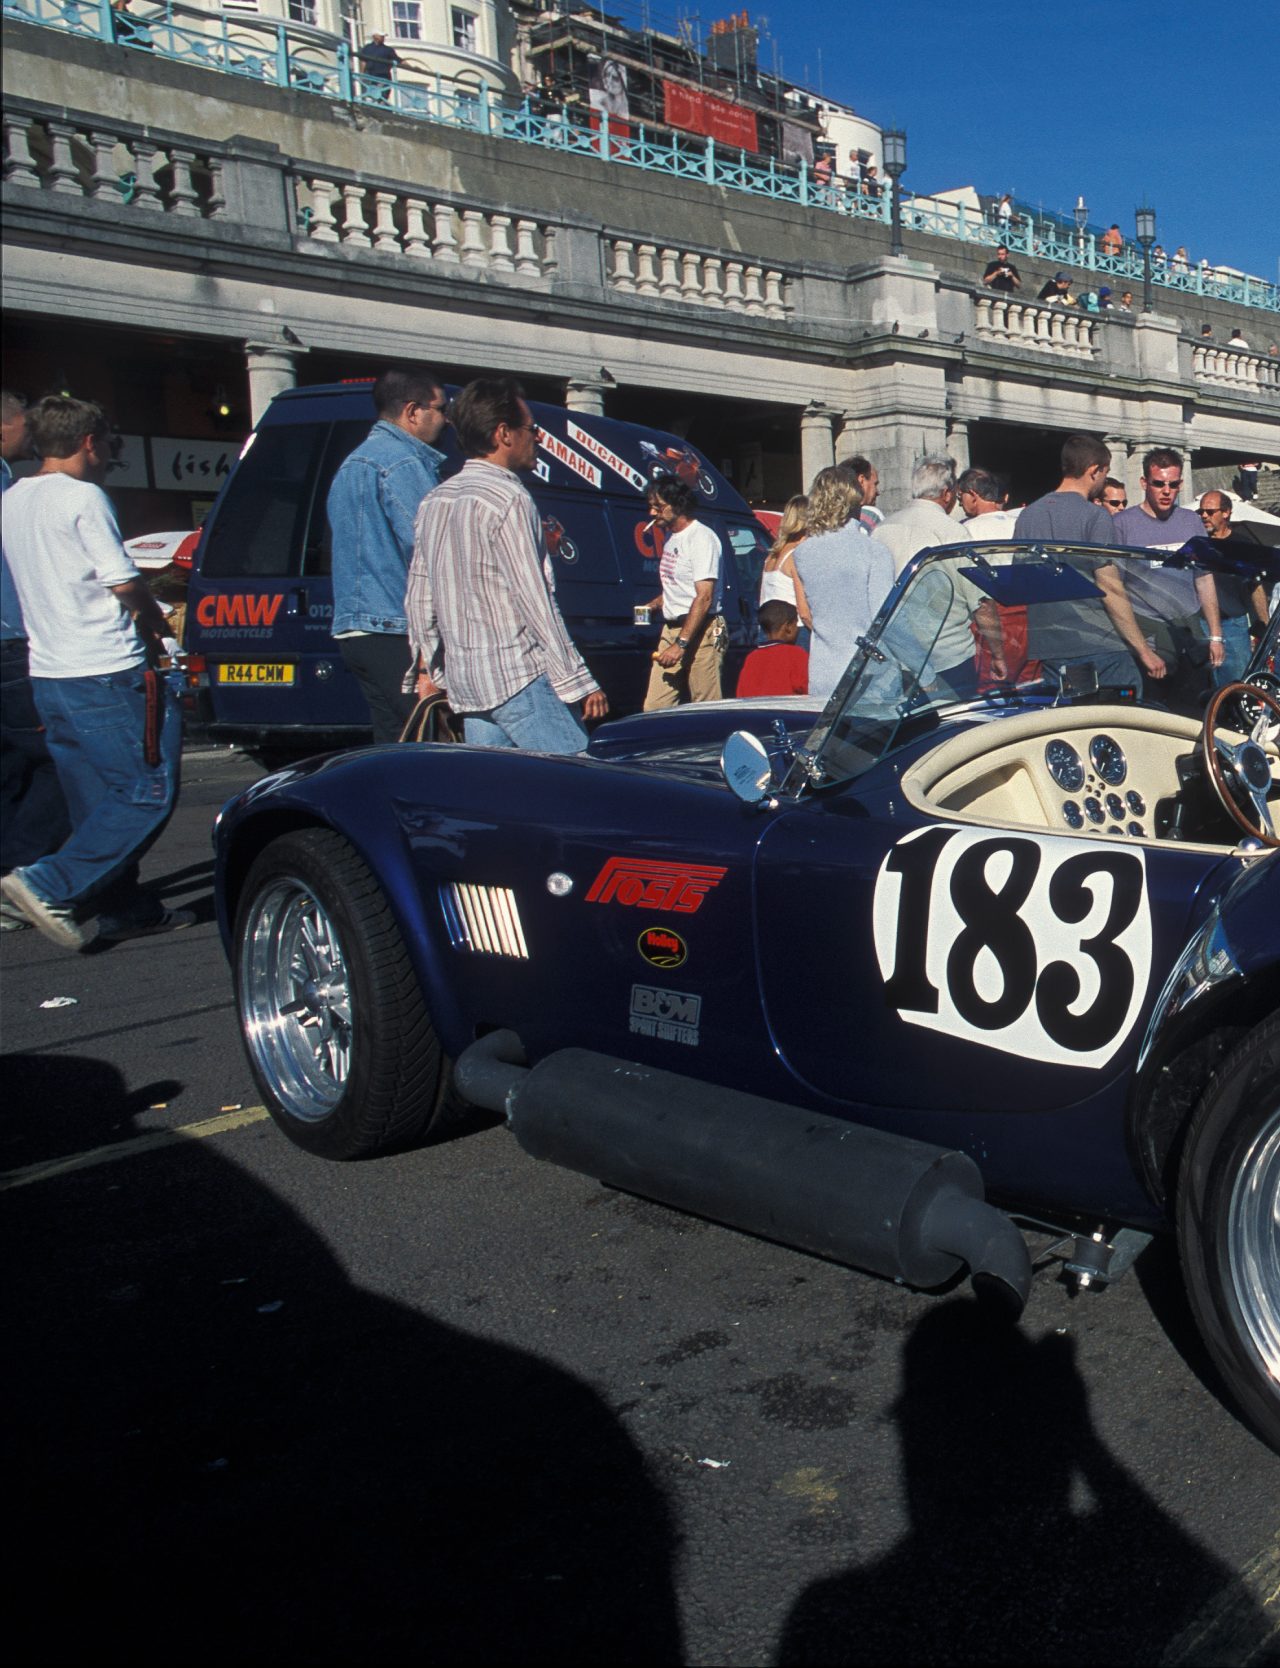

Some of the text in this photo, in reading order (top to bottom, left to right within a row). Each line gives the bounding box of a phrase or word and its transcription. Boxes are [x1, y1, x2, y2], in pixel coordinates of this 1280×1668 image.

[536, 430, 595, 484] YAMAHA
[576, 429, 630, 477] DUCATI
[197, 594, 284, 627] CMW
[200, 628, 274, 639] MOTORCYCLES
[226, 665, 284, 682] R44 CMW
[647, 931, 679, 953] Holley
[884, 827, 1144, 1053] 183
[633, 987, 698, 1024] B&M
